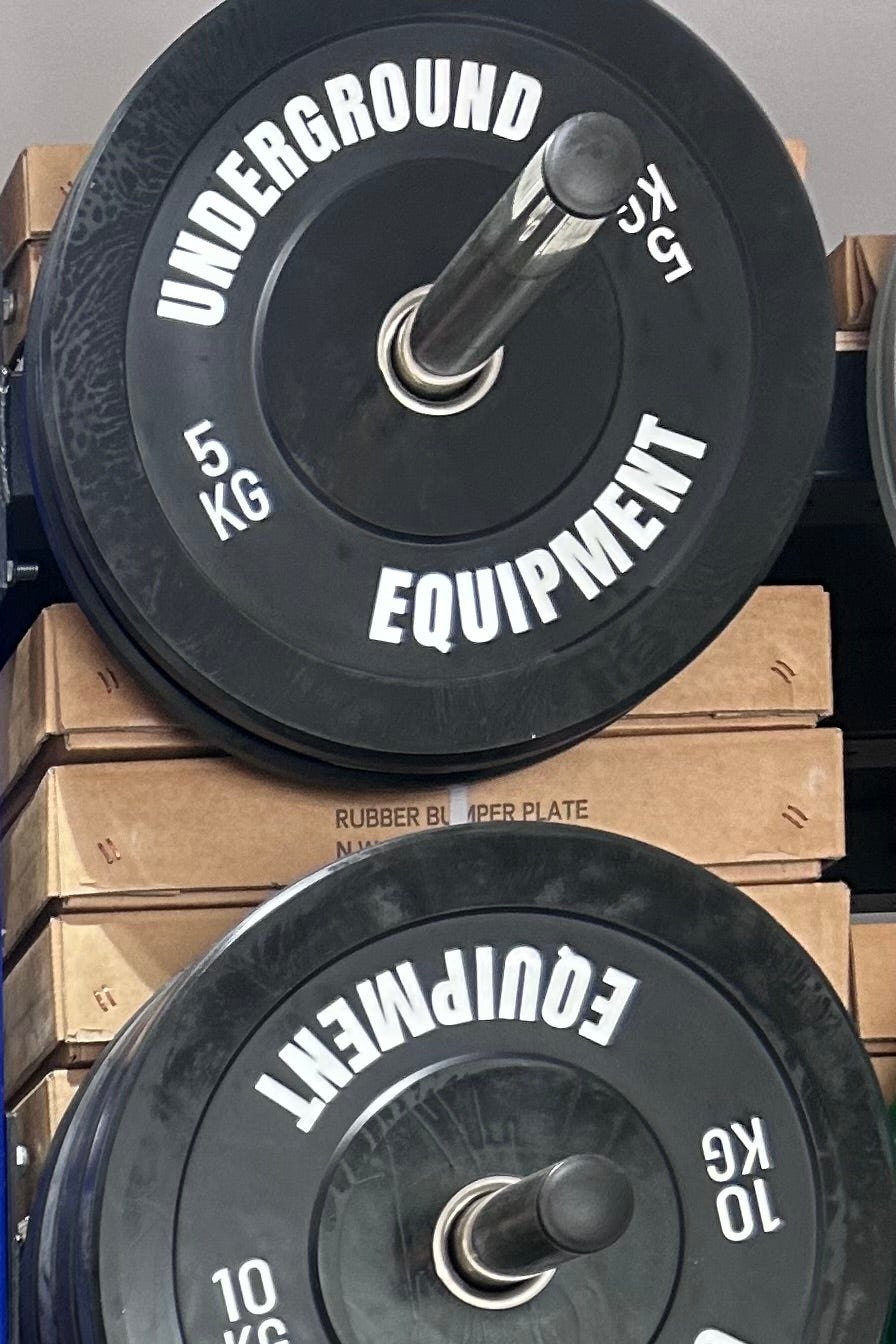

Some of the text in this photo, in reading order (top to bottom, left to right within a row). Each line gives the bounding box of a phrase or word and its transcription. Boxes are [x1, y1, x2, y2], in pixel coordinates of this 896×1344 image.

[156, 57, 543, 328] UNDERGROUND
[647, 226, 693, 283] 5
[183, 418, 230, 478] 5
[199, 468, 272, 542] KG
[368, 413, 708, 654] EQUIPMENT
[336, 807, 419, 829] RUBBER
[522, 799, 589, 821] PLATE
[254, 945, 638, 1133] EQUIPMENT
[701, 1116, 772, 1183] KG
[717, 1179, 784, 1242] 10
[211, 1257, 277, 1322] 10
